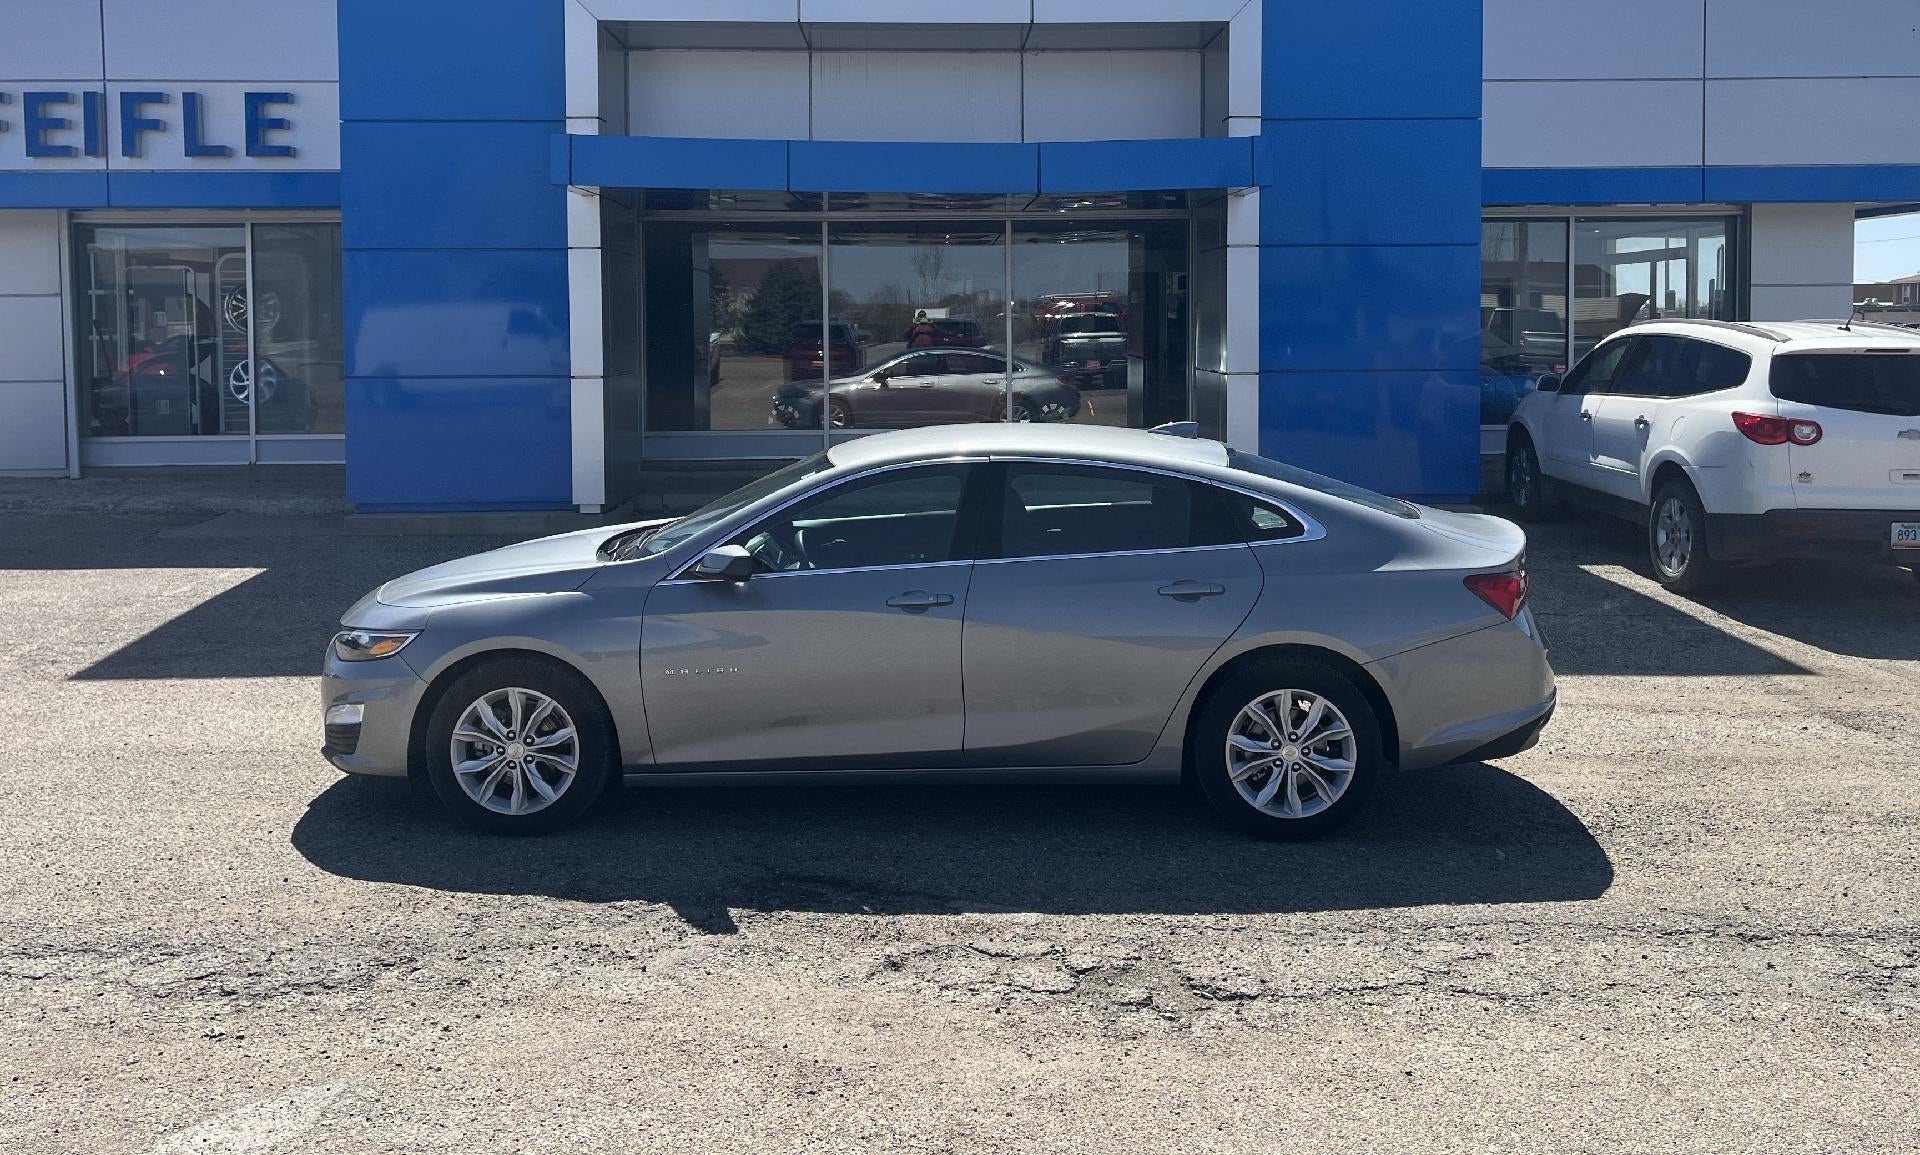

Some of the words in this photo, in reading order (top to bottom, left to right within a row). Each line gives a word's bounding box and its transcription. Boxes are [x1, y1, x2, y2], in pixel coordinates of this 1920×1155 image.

[0, 91, 297, 158] EIFLE
[1897, 529, 1917, 541] 893
[664, 666, 739, 676] MALIBU
